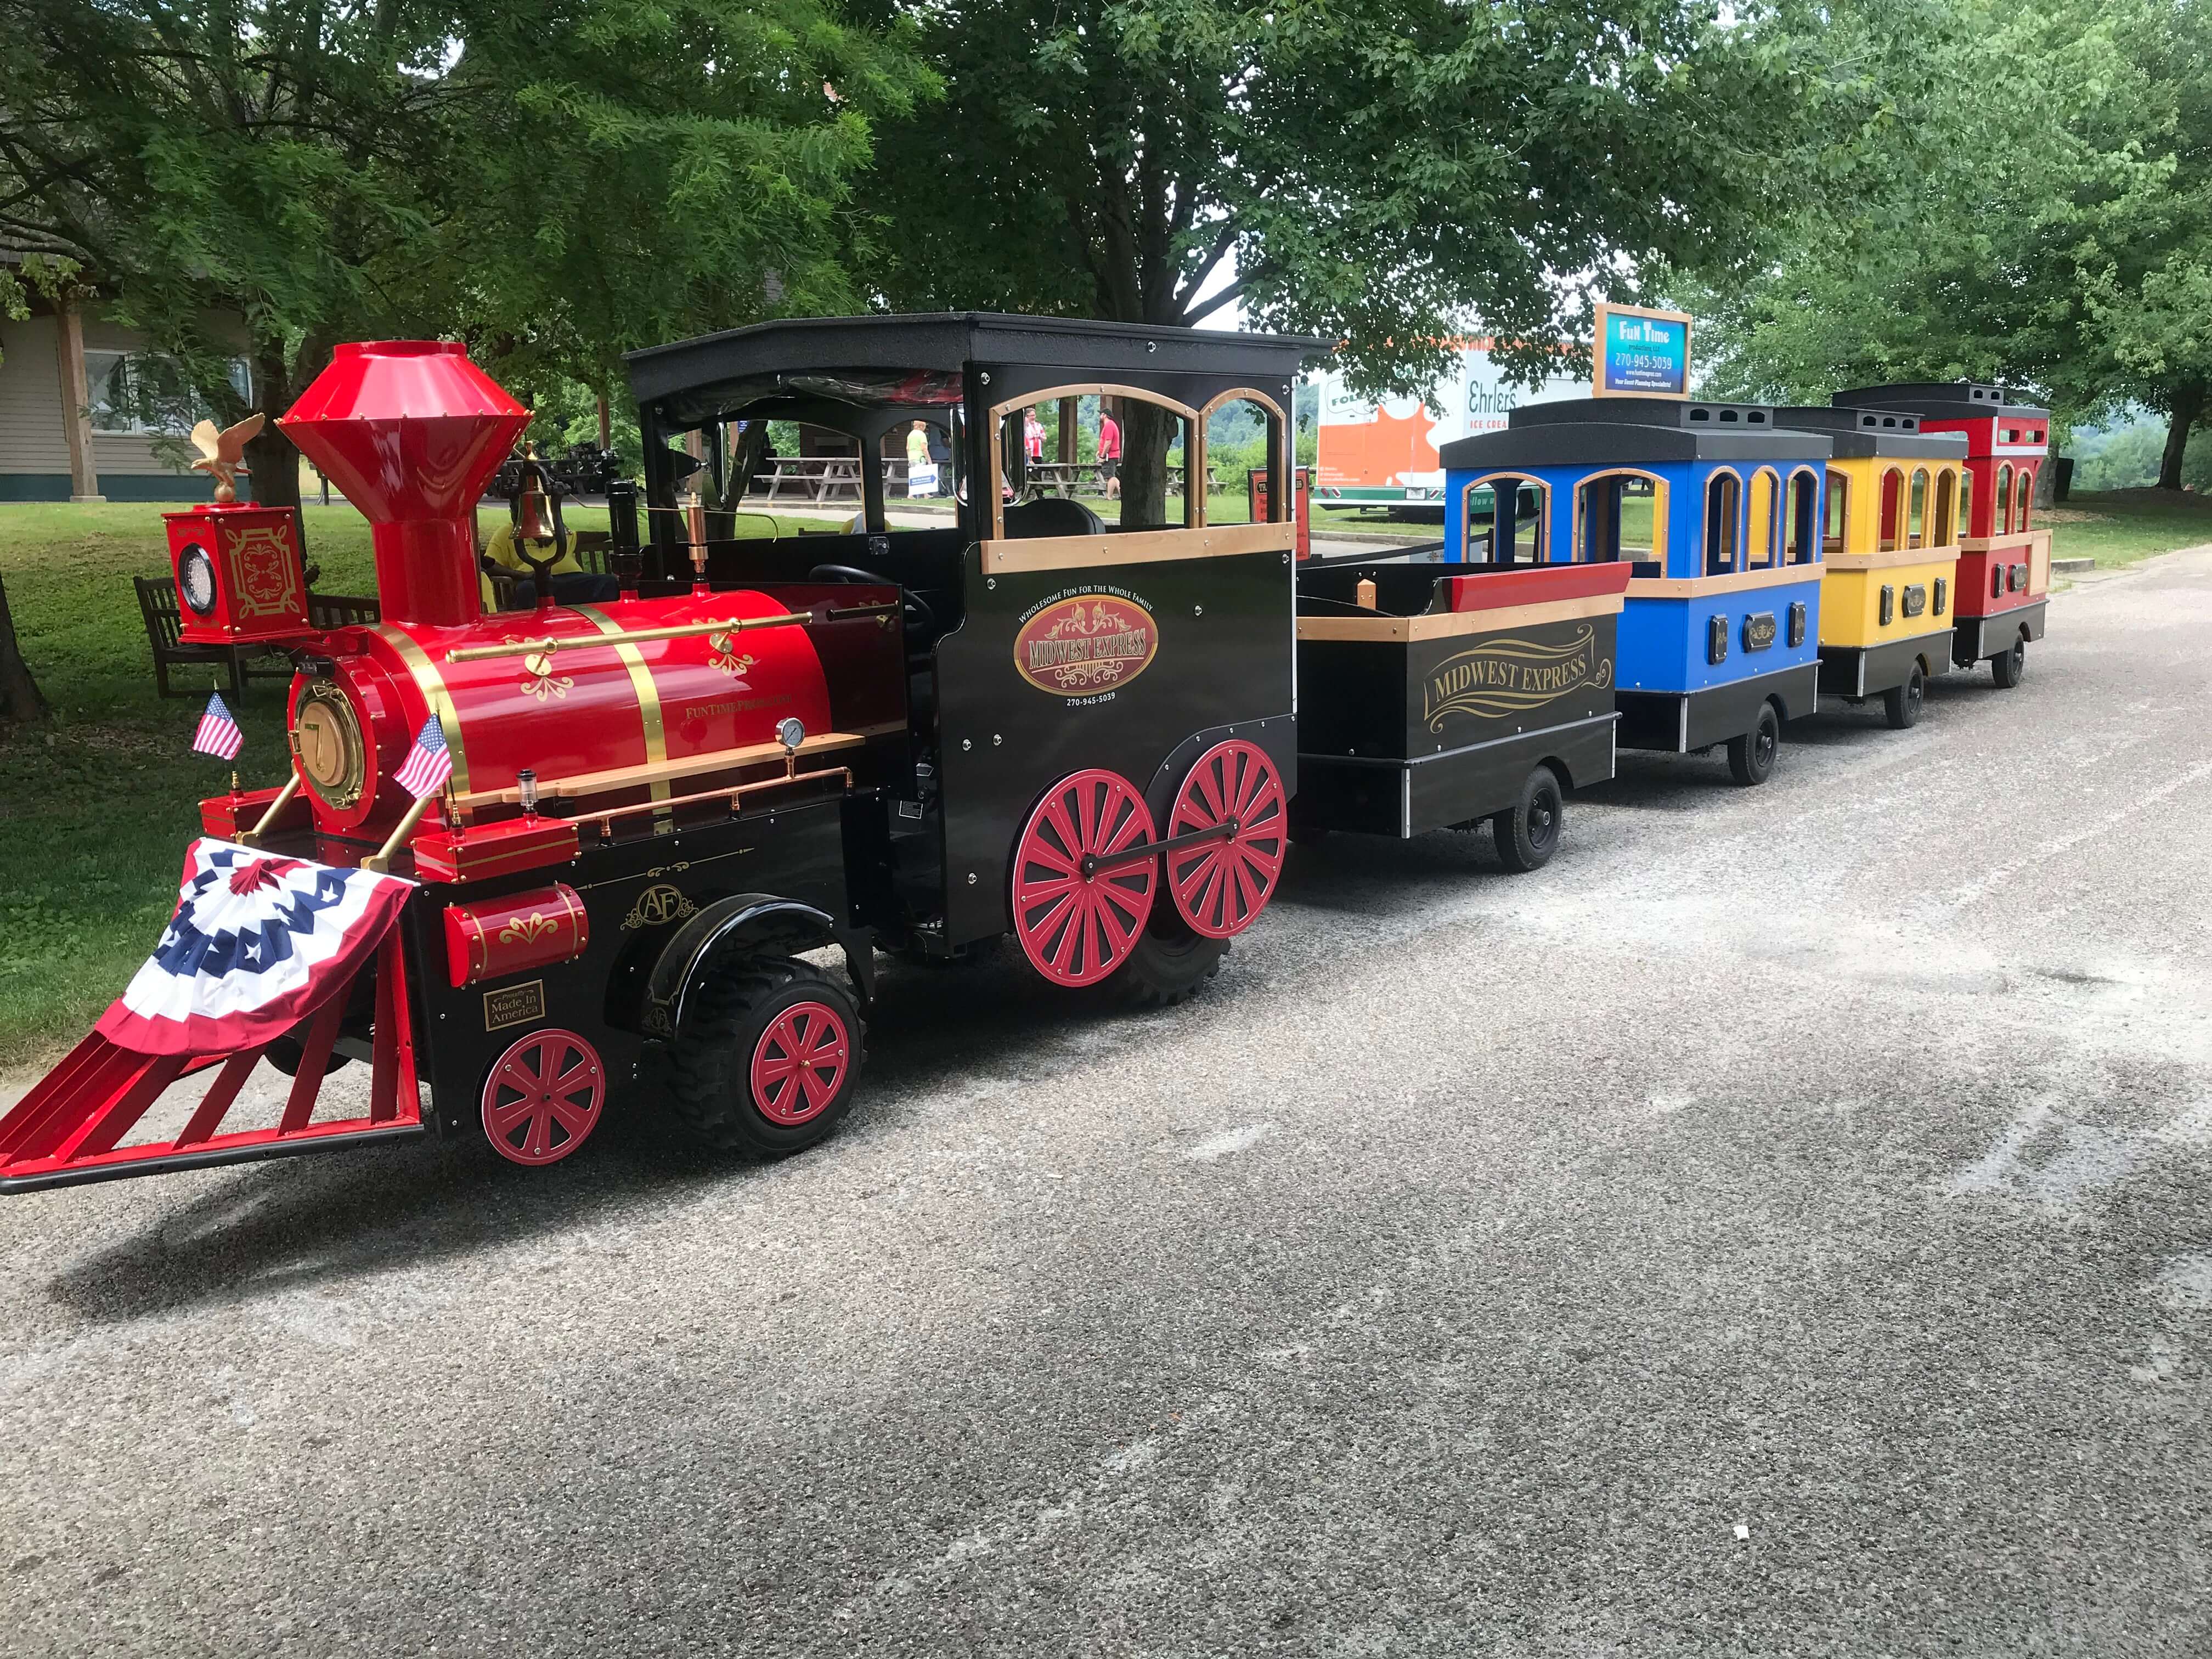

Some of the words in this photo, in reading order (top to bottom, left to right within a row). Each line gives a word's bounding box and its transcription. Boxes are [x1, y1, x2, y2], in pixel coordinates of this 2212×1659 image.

[1615, 352, 1672, 370] 270-945-5039
[1634, 379, 1651, 387] Planning
[1469, 380, 1516, 413] Ehrler's
[1470, 420, 1483, 428] ICE
[1487, 420, 1507, 428] CREA
[1018, 592, 1062, 623] WHOLESOME
[1063, 587, 1077, 597] FUN
[1079, 585, 1092, 594] FOR
[1108, 585, 1131, 598] WHOLE
[1132, 592, 1153, 611] FAMILY
[1029, 638, 1091, 669] MIDWEST
[1093, 628, 1146, 658] EXPRESS
[1434, 661, 1519, 703] MIDWEST
[1521, 653, 1586, 691] EXPRESS
[1066, 691, 1116, 706] 270-945-5039
[644, 889, 678, 920] AF
[491, 998, 522, 1014] Made
[526, 995, 537, 1005] In
[492, 1005, 538, 1024] America
